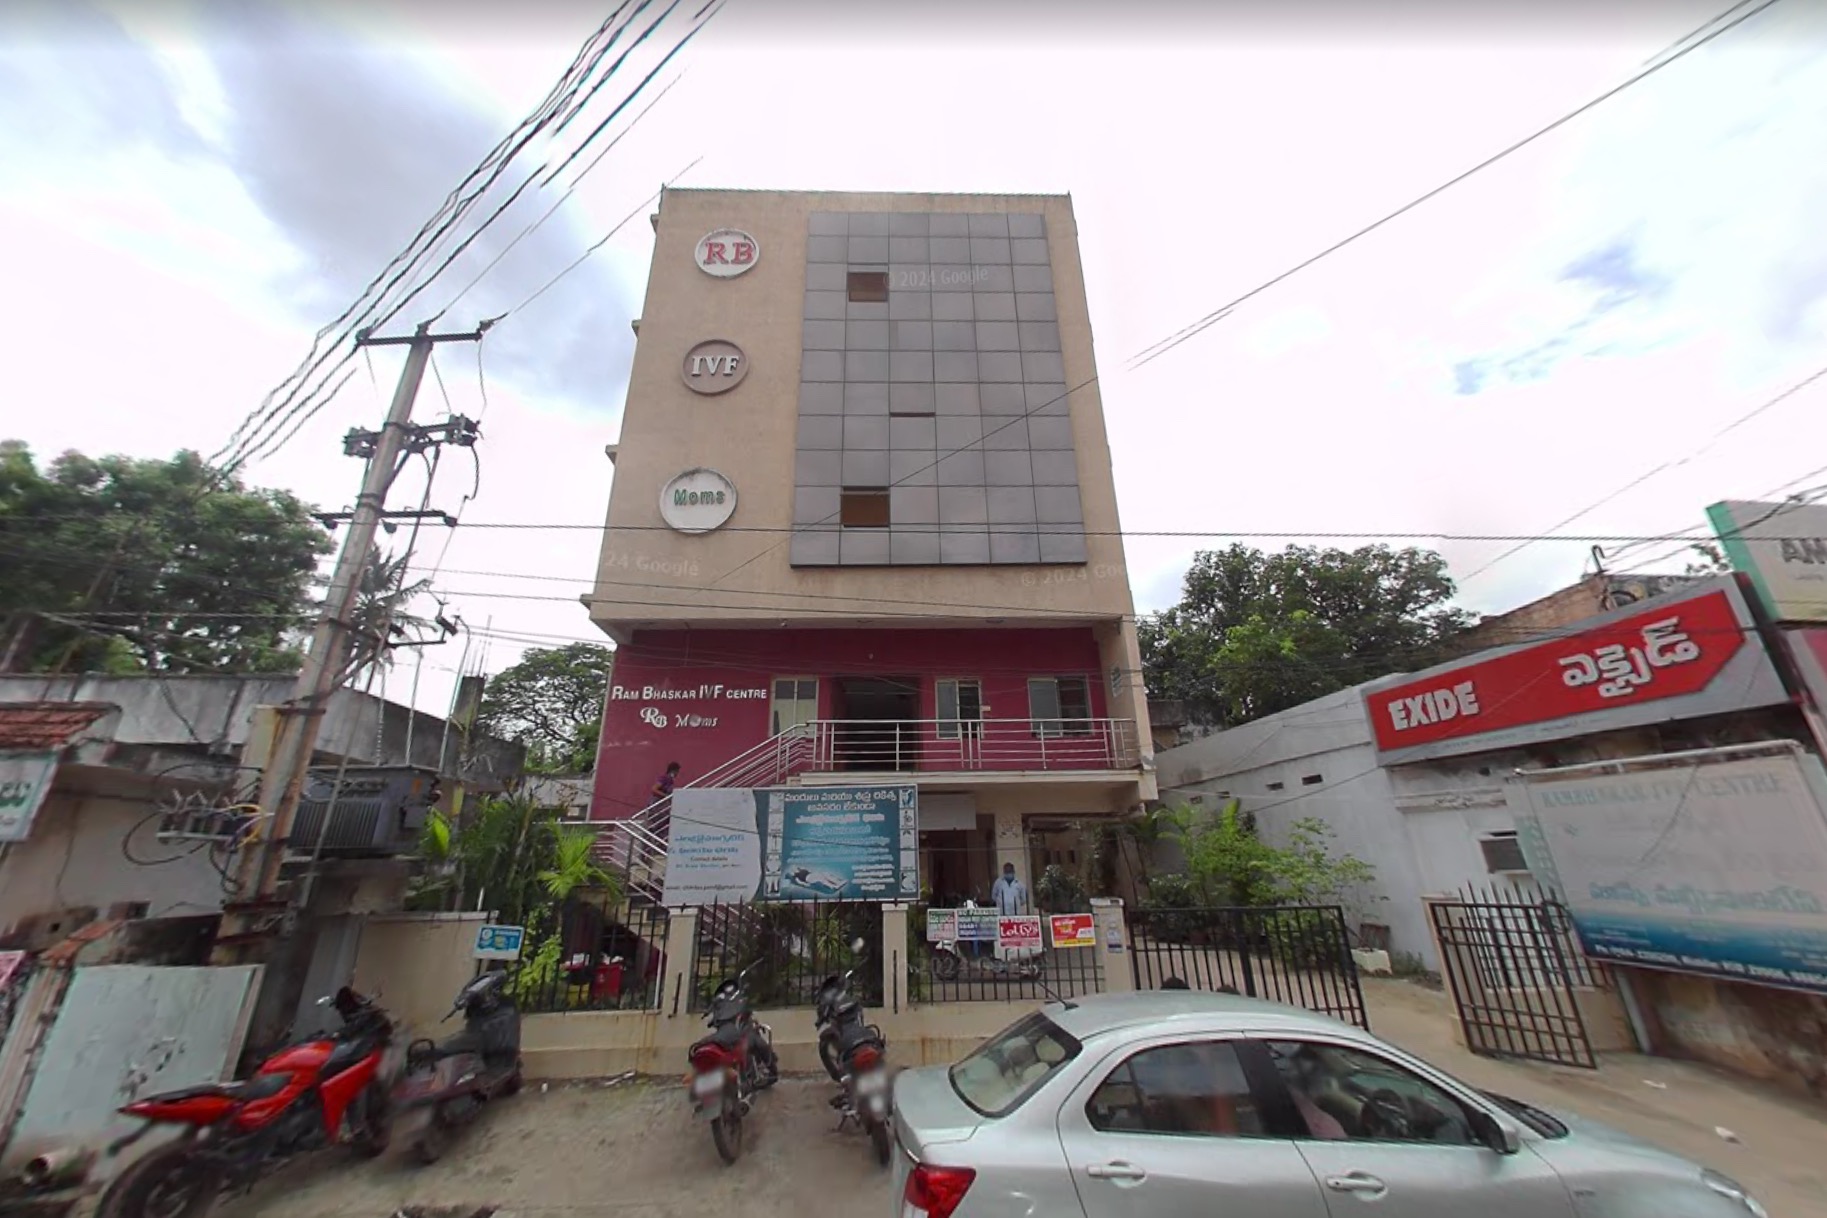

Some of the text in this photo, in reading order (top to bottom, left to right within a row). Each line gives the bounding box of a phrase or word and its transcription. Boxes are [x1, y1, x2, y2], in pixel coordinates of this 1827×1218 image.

[703, 241, 755, 265] RB
[691, 355, 740, 376] IVF
[673, 488, 726, 506] Moms
[611, 684, 767, 700] RAM BHASKAR IVF CENTRE
[1387, 681, 1480, 731] EXIDE
